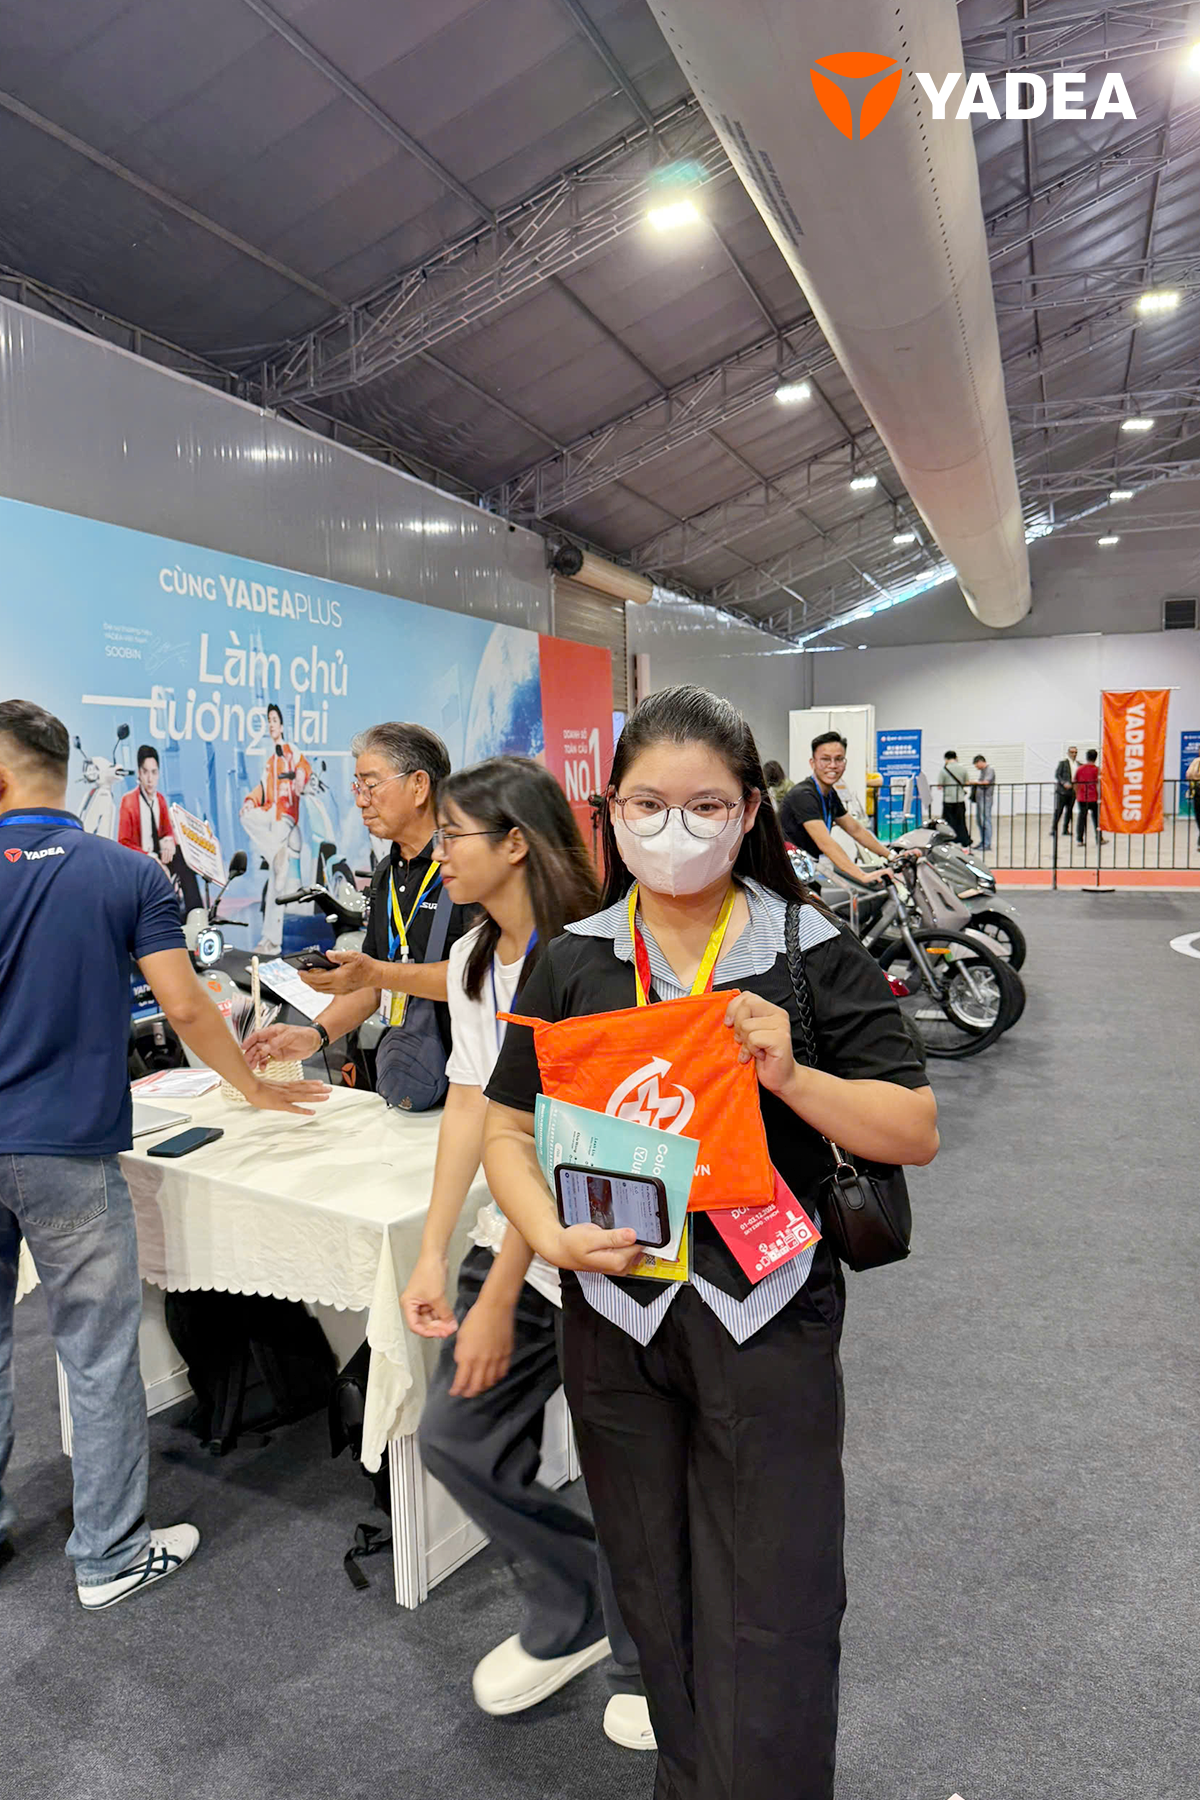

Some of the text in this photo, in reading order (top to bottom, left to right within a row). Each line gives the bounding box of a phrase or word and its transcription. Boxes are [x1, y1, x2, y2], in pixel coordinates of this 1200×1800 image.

[159, 565, 343, 628] CÙNG YADEAPLUS
[105, 645, 142, 660] SOOBIN
[199, 630, 282, 690] Làm
[290, 645, 348, 696] chủ
[149, 685, 328, 756] tương lai
[1122, 703, 1146, 822] YADEAPLUS
[24, 846, 65, 860] YADEA
